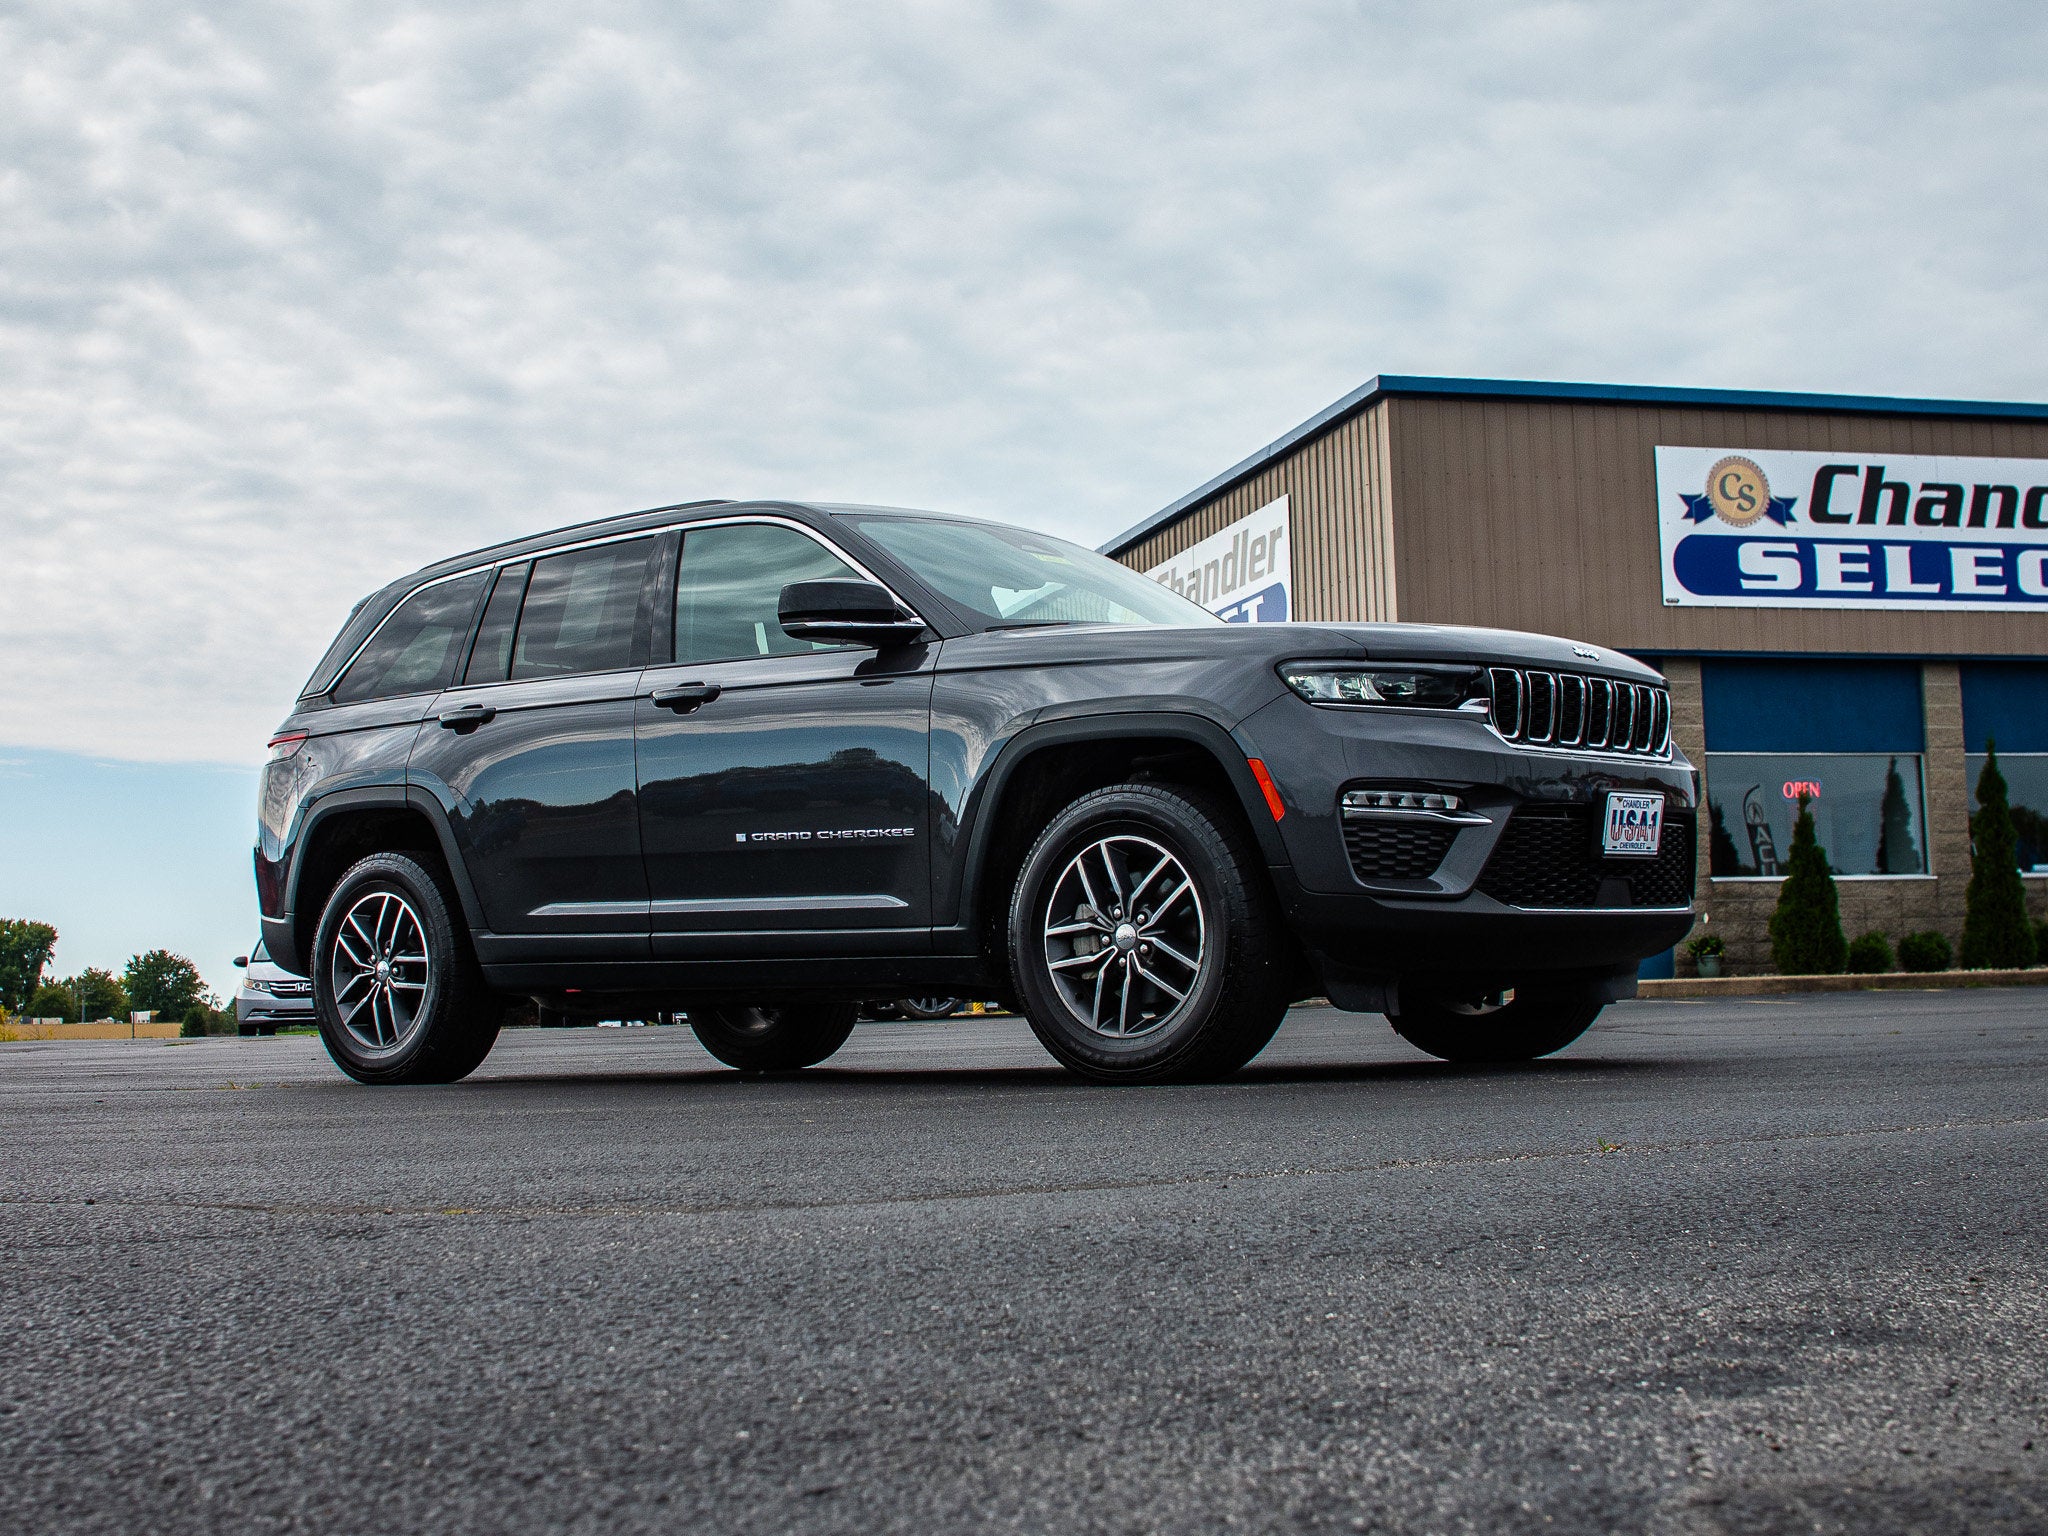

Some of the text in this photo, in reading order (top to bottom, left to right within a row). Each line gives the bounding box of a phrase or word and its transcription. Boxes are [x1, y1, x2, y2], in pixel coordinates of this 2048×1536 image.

[1157, 525, 1283, 605] handler
[1782, 781, 1821, 799] OPEN
[1622, 799, 1651, 810] CHANDLER
[751, 827, 915, 842] GRAND CHEROKEE
[1619, 842, 1646, 850] CHEVROLET
